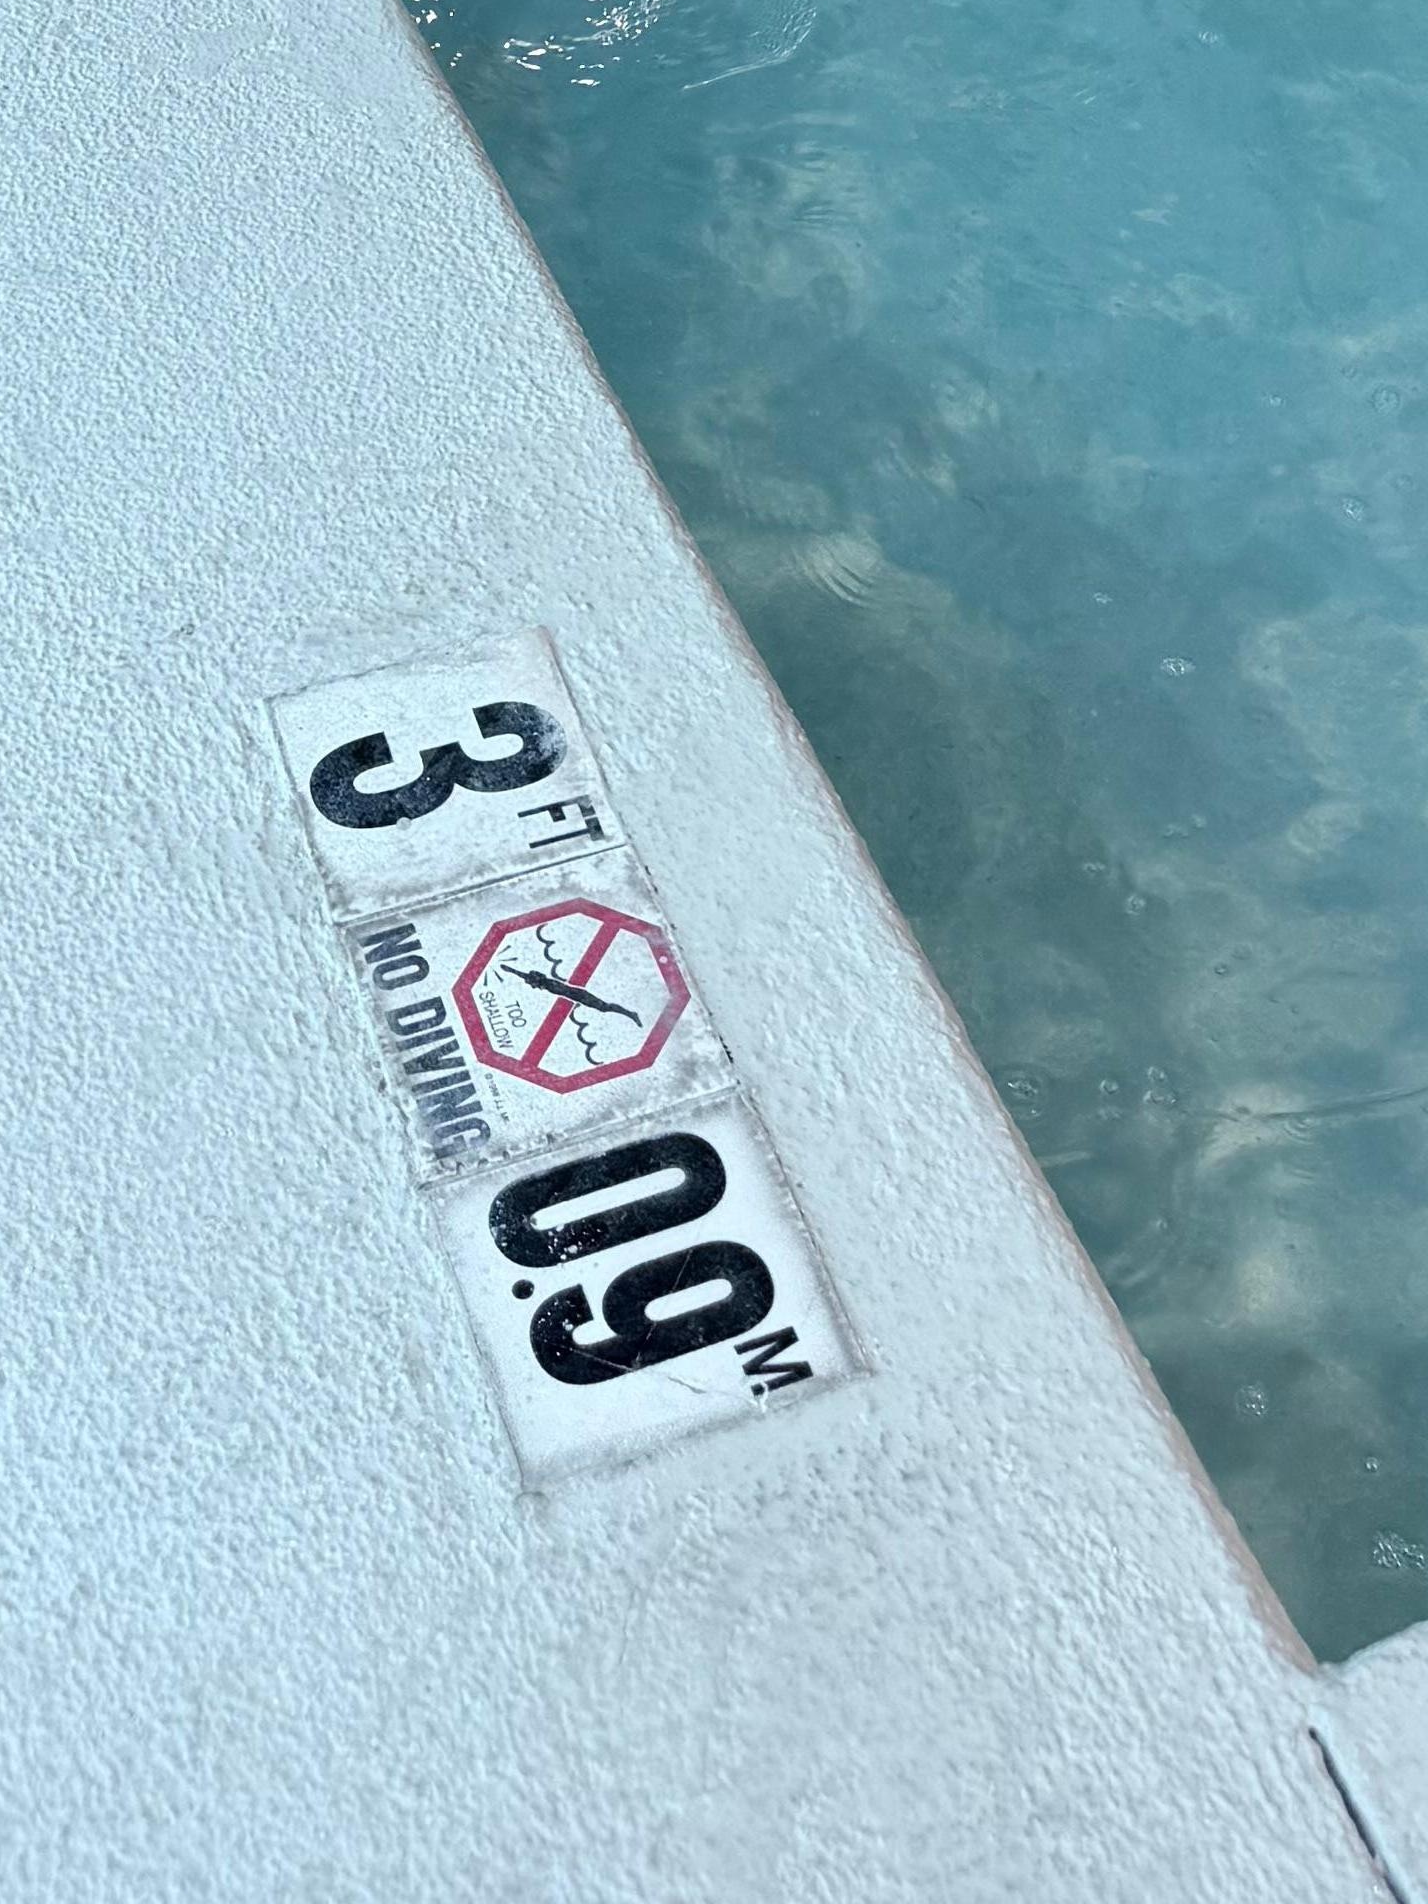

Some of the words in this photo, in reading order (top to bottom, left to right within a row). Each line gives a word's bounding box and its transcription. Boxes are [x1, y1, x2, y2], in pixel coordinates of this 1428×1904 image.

[310, 701, 567, 829] 3
[517, 794, 605, 849] FT
[359, 923, 430, 991] NO
[479, 991, 514, 1049] SHALLOW
[505, 1000, 527, 1029] TOO
[384, 996, 491, 1160] DIVING
[489, 1132, 775, 1385] 0.9
